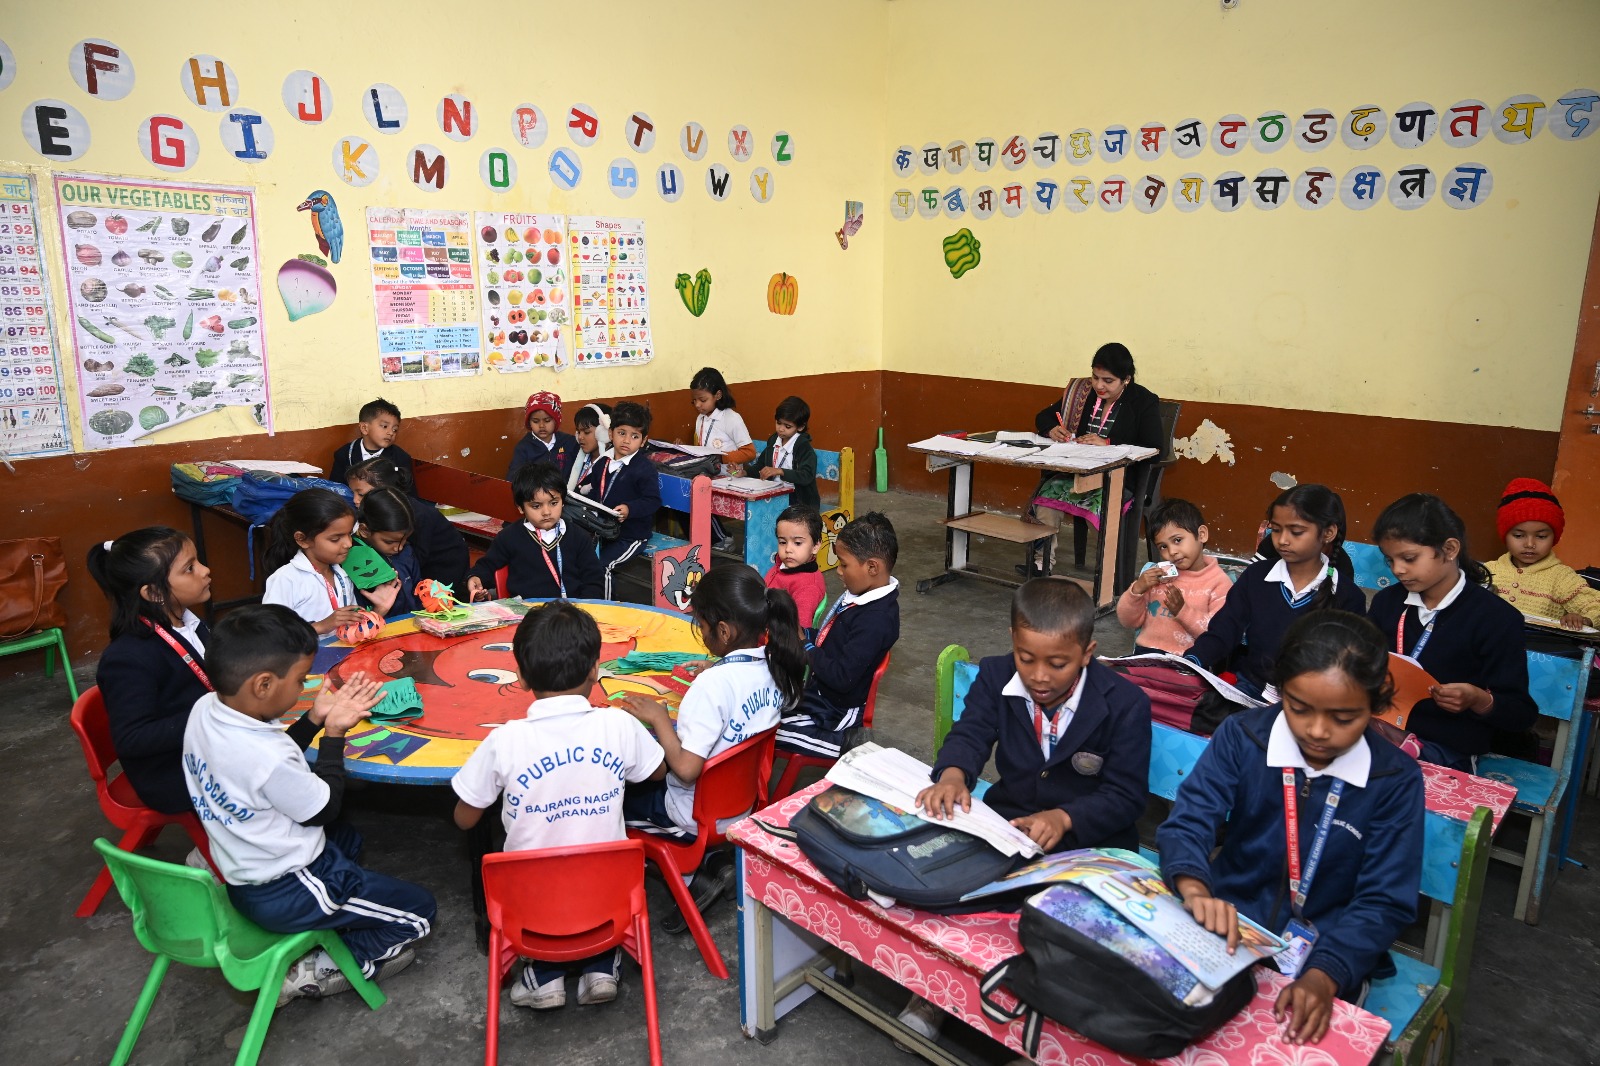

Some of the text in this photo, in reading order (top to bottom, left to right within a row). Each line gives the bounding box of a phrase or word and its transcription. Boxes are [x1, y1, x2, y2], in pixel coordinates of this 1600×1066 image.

[84, 43, 791, 161] F H J L N P R T V X Z
[895, 149, 912, 171] क
[923, 147, 942, 170] ख
[947, 145, 969, 167] ग
[975, 141, 995, 166] घ
[1032, 134, 1060, 162] च
[1069, 131, 1093, 159] छ
[1103, 129, 1128, 156] ज
[1139, 126, 1167, 153] झ
[1218, 121, 1246, 149] ट
[1256, 114, 1286, 143] ठ
[1301, 113, 1335, 144] ड
[1394, 108, 1436, 143] ण
[1449, 104, 1485, 138] त
[1501, 101, 1546, 140] थ
[1557, 95, 1600, 138] द
[35, 105, 72, 155] E
[150, 116, 185, 167] G
[230, 113, 267, 159] I
[342, 140, 369, 182] K
[413, 150, 445, 189] M
[660, 169, 677, 195] U
[709, 168, 730, 198] W
[754, 172, 769, 199] Y
[62, 183, 211, 211] OUR VEGETABLES
[894, 191, 911, 215] प
[921, 188, 939, 210] फ
[943, 188, 966, 212] ब
[978, 189, 993, 211] भ
[1003, 185, 1023, 209] म
[1035, 181, 1058, 210] य
[1070, 179, 1091, 206] र
[1100, 180, 1125, 206] ल
[1144, 175, 1166, 208] व
[1213, 176, 1246, 208] ष
[1252, 175, 1290, 205] स
[1304, 171, 1333, 205] ह
[1352, 171, 1381, 200] क्ष
[1449, 167, 1487, 203] ज्ञ
[12, 204, 28, 214] 91
[503, 214, 537, 225] FRUITS
[595, 220, 622, 231] Shapes
[14, 224, 33, 234] 92
[17, 246, 35, 255] 93
[20, 266, 38, 275] 94
[1, 286, 40, 295] 85 95
[4, 306, 43, 316] 86 96
[7, 326, 45, 336] 87 97
[10, 346, 49, 356] 88 98
[14, 367, 31, 375] 89
[35, 366, 52, 375] 99
[17, 386, 55, 396] 90 100
[742, 687, 770, 720] PUBLIC
[517, 746, 585, 790] PUBLIC
[591, 747, 626, 790] SCHO
[525, 787, 620, 814] BAJRANG NAGAR
[545, 805, 610, 824] VARANASI
[1288, 818, 1297, 841] SCHOOL
[1290, 841, 1298, 865] PUBLIC
[1312, 836, 1326, 862] SCHOOL
